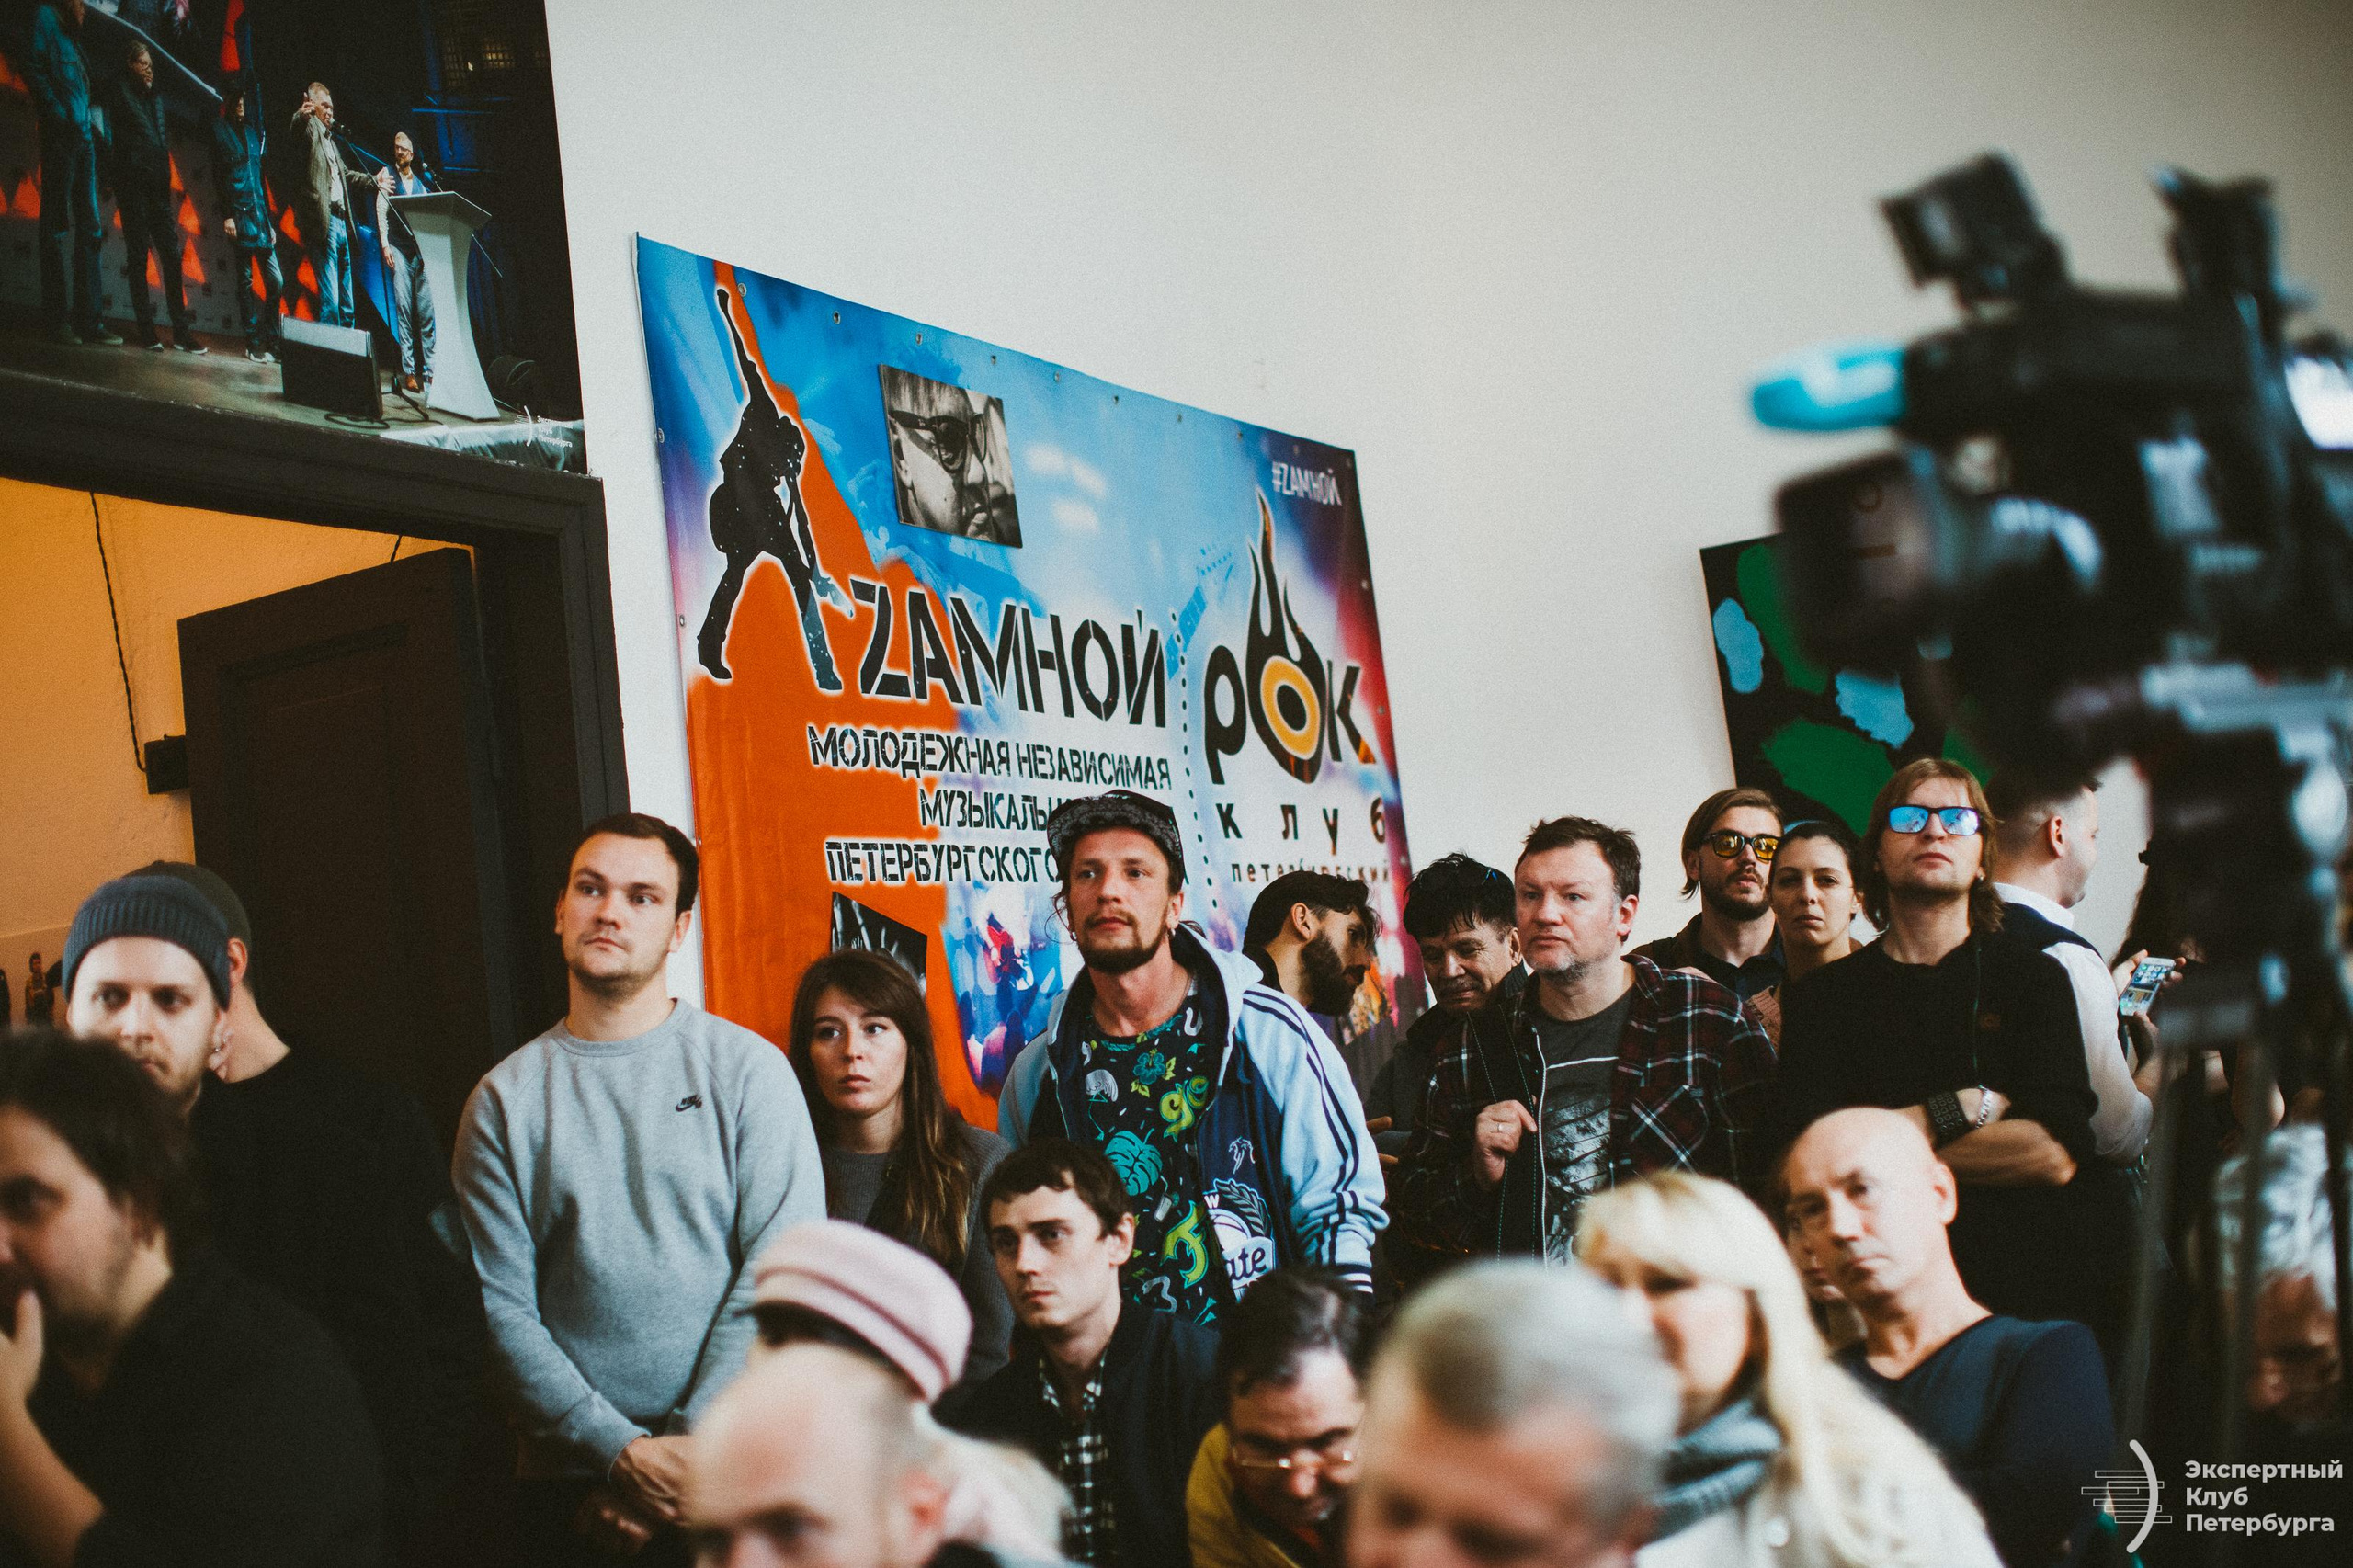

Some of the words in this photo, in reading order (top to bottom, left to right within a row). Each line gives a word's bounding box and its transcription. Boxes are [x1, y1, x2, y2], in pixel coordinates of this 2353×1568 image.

[807, 725, 1012, 778] МОЛОДЕЖНАЯ
[1017, 743, 1172, 790] НЕЗАВИСИМАЯ
[919, 788, 1073, 832] МУЗЫКАЛЬ
